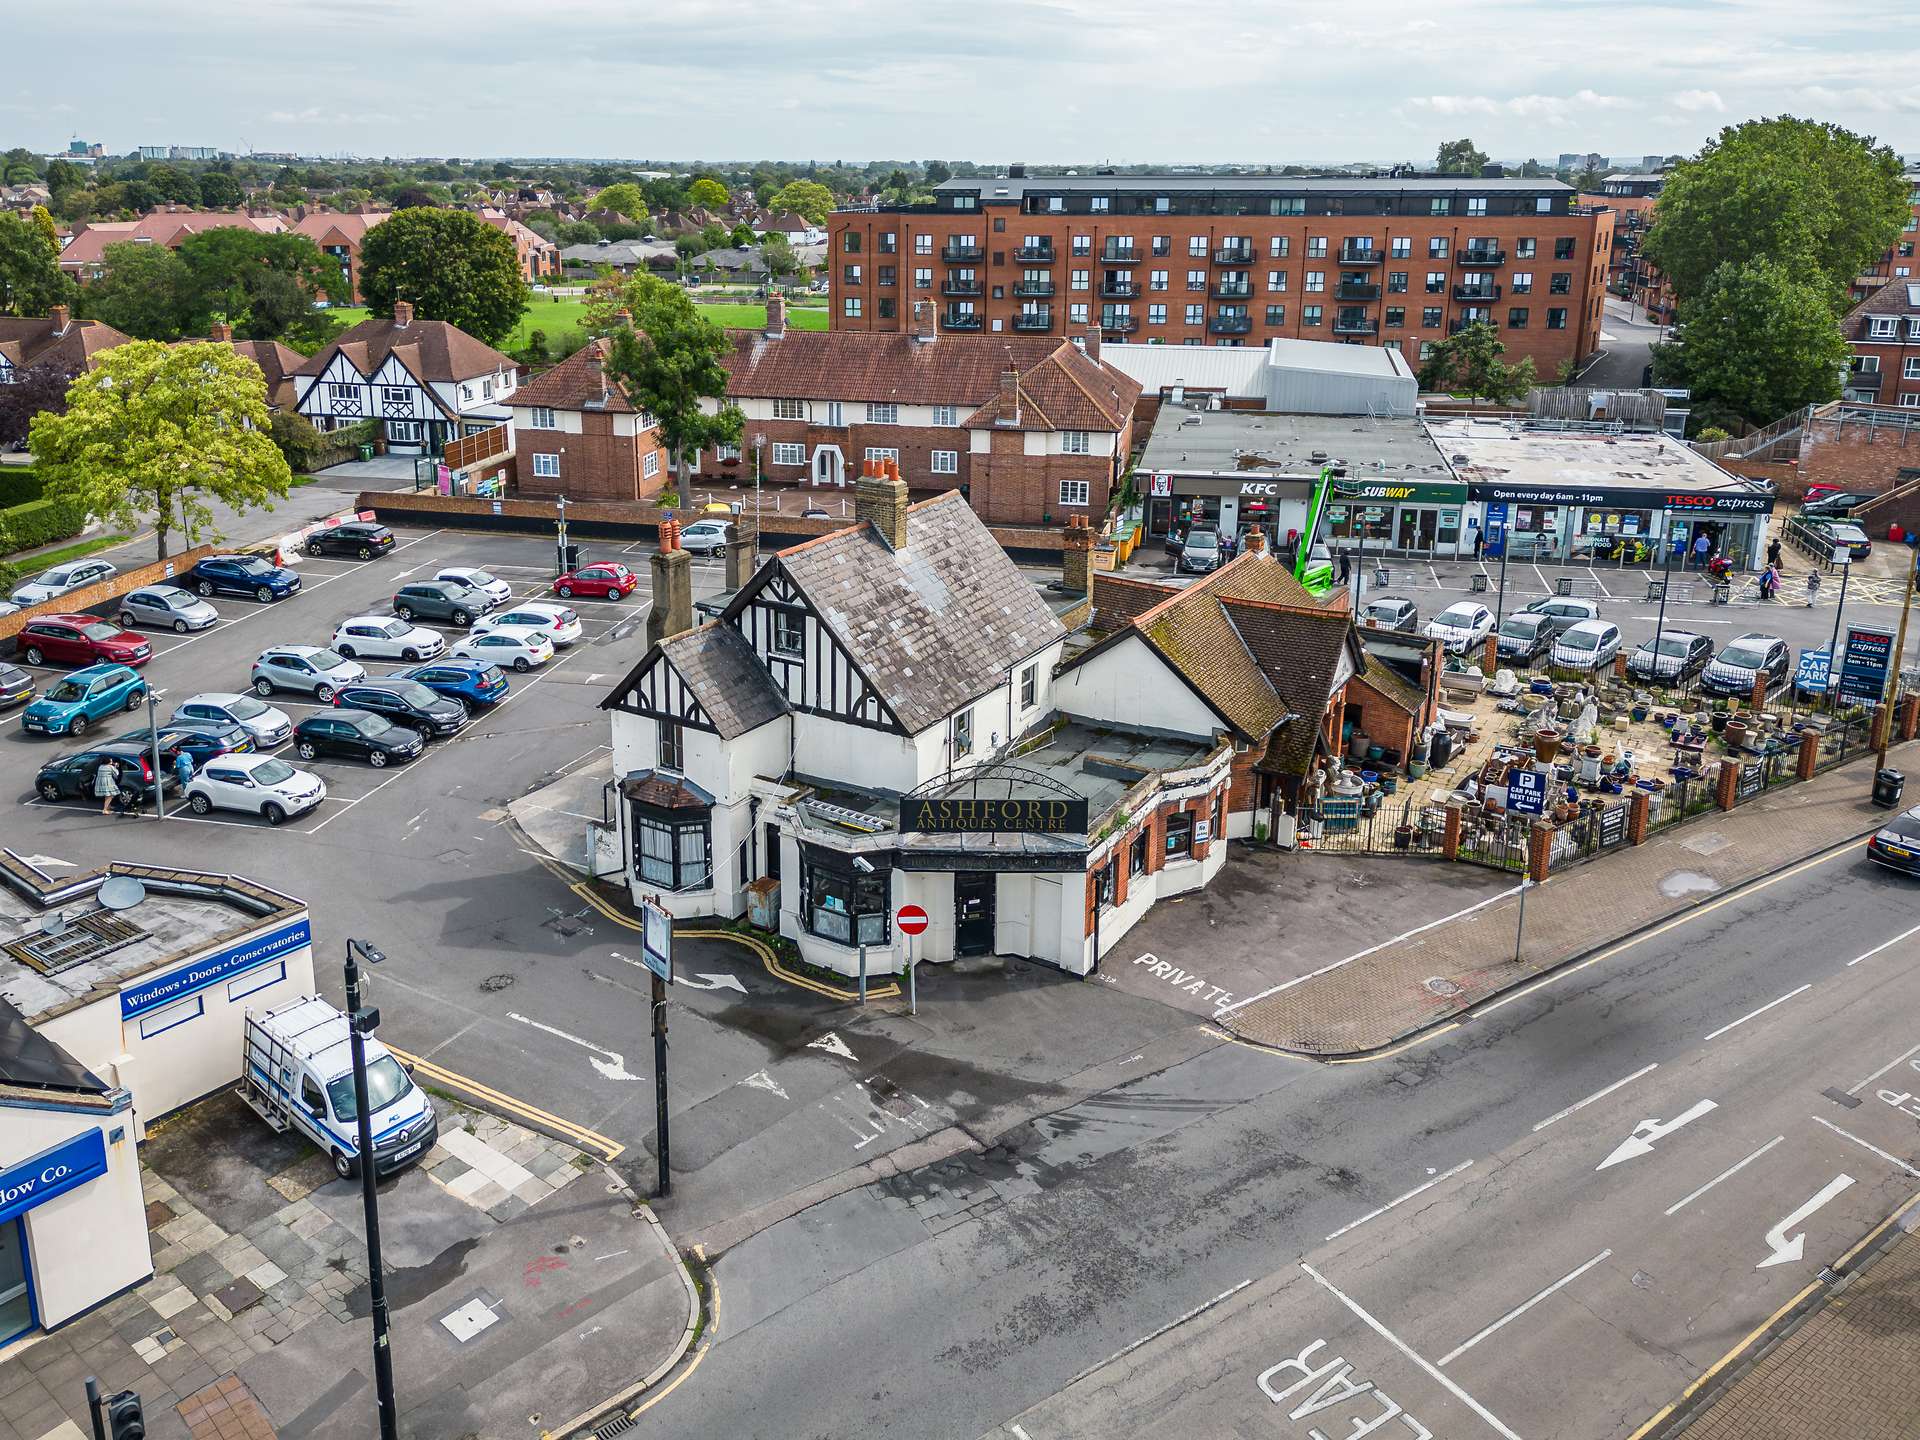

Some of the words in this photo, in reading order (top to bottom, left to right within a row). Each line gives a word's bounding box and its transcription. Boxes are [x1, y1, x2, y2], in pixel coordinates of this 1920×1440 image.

[1240, 483, 1277, 495] KFC
[1361, 486, 1415, 498] SUBWAY
[1493, 489, 1515, 499] Open
[1517, 491, 1539, 500] every
[1540, 492, 1555, 500] day
[1582, 494, 1603, 502] 11pm
[1666, 495, 1714, 506] TESCO
[1717, 498, 1765, 510] express
[1853, 633, 1889, 644] TESCO
[1851, 643, 1886, 653] express
[1800, 659, 1828, 671] CAR
[1798, 669, 1827, 681] PARK
[1521, 776, 1532, 786] P
[1510, 786, 1524, 795] CAR
[1524, 788, 1541, 798] PARK
[1509, 793, 1525, 801] NEXT
[1526, 796, 1541, 804] LEFT
[919, 801, 1068, 819] ASHFORD
[916, 818, 997, 831] ANTIQUES
[1004, 818, 1066, 829] CENTRE
[127, 980, 180, 1008] Windows
[188, 964, 222, 984] Doors
[230, 930, 305, 966] Conservatories
[1133, 953, 1234, 1009] PRIVATE
[41, 1165, 72, 1183] Co.
